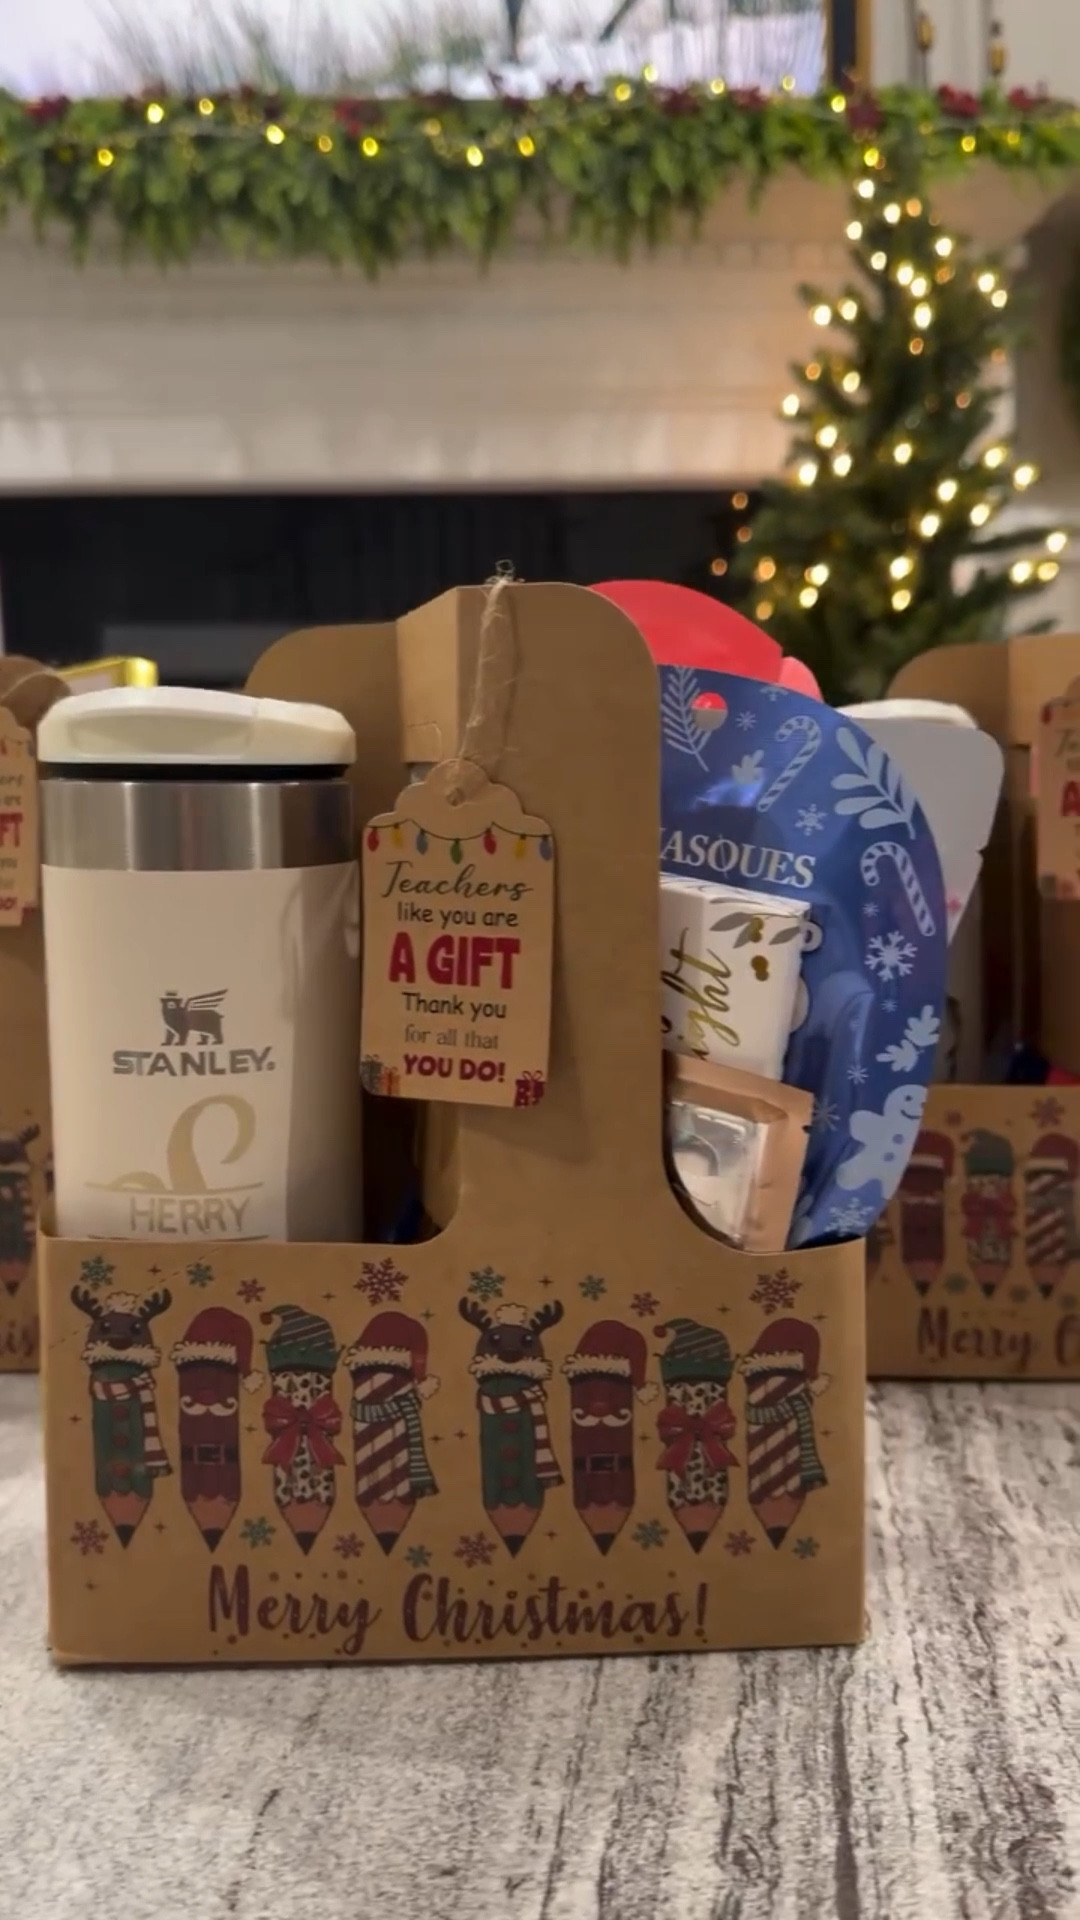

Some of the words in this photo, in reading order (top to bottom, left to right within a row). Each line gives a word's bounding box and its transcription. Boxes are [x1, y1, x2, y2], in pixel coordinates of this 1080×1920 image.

[659, 828, 816, 889] ASQUES
[381, 859, 534, 901] Teachers
[397, 902, 434, 923] like
[440, 906, 476, 929] you
[482, 910, 519, 928] are
[388, 931, 416, 984] A
[427, 934, 521, 990] GIFT
[402, 991, 464, 1016] Thank
[471, 1001, 507, 1023] you
[404, 1023, 431, 1044] for
[436, 1026, 458, 1046] all
[464, 1031, 499, 1049] that
[404, 1054, 453, 1078] YOU
[459, 1058, 506, 1084] DO!
[208, 1564, 382, 1656] Merry
[402, 1572, 709, 1643] Christmas!
